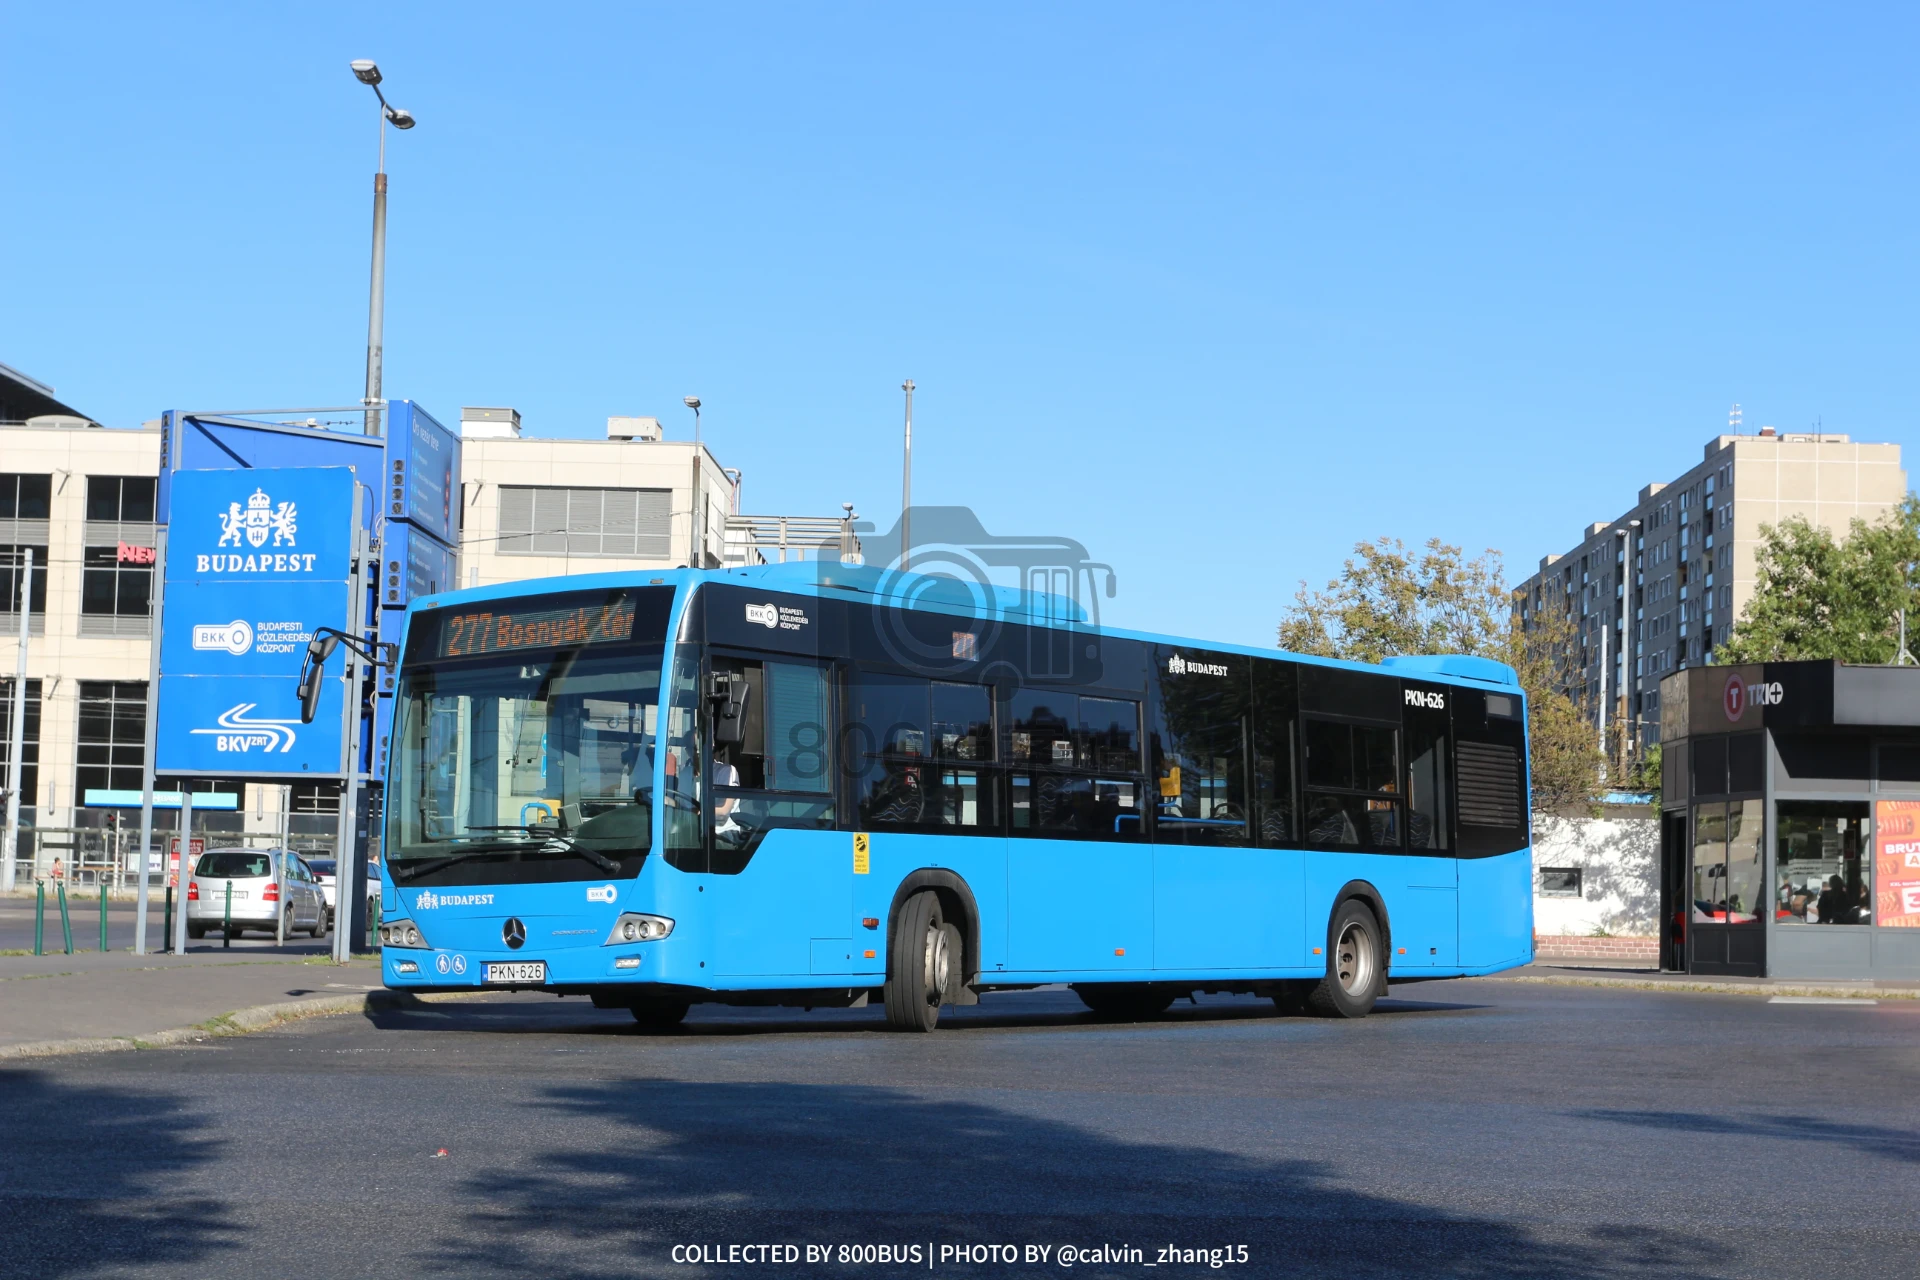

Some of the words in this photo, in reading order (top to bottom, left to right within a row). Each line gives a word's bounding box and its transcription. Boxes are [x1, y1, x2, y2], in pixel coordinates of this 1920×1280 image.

[196, 554, 316, 572] BUDAPEST
[750, 609, 764, 619] BKK
[779, 606, 804, 616] BUDAPESTI
[257, 622, 302, 631] BUDAPESTI
[448, 613, 493, 656] 277
[497, 608, 590, 647] Bosnyák
[600, 605, 635, 637] tér
[779, 621, 801, 630] KÖZPONT
[201, 632, 225, 642] BKK
[257, 632, 312, 642] KÖZLEKEDÉSI
[256, 642, 296, 653] KÖZPONT
[1187, 661, 1228, 676] BUDAPEST
[1404, 689, 1445, 710] PKN-626
[217, 735, 251, 752] BKV
[441, 894, 494, 905] BUDAPEST
[490, 964, 542, 979] PKN-626
